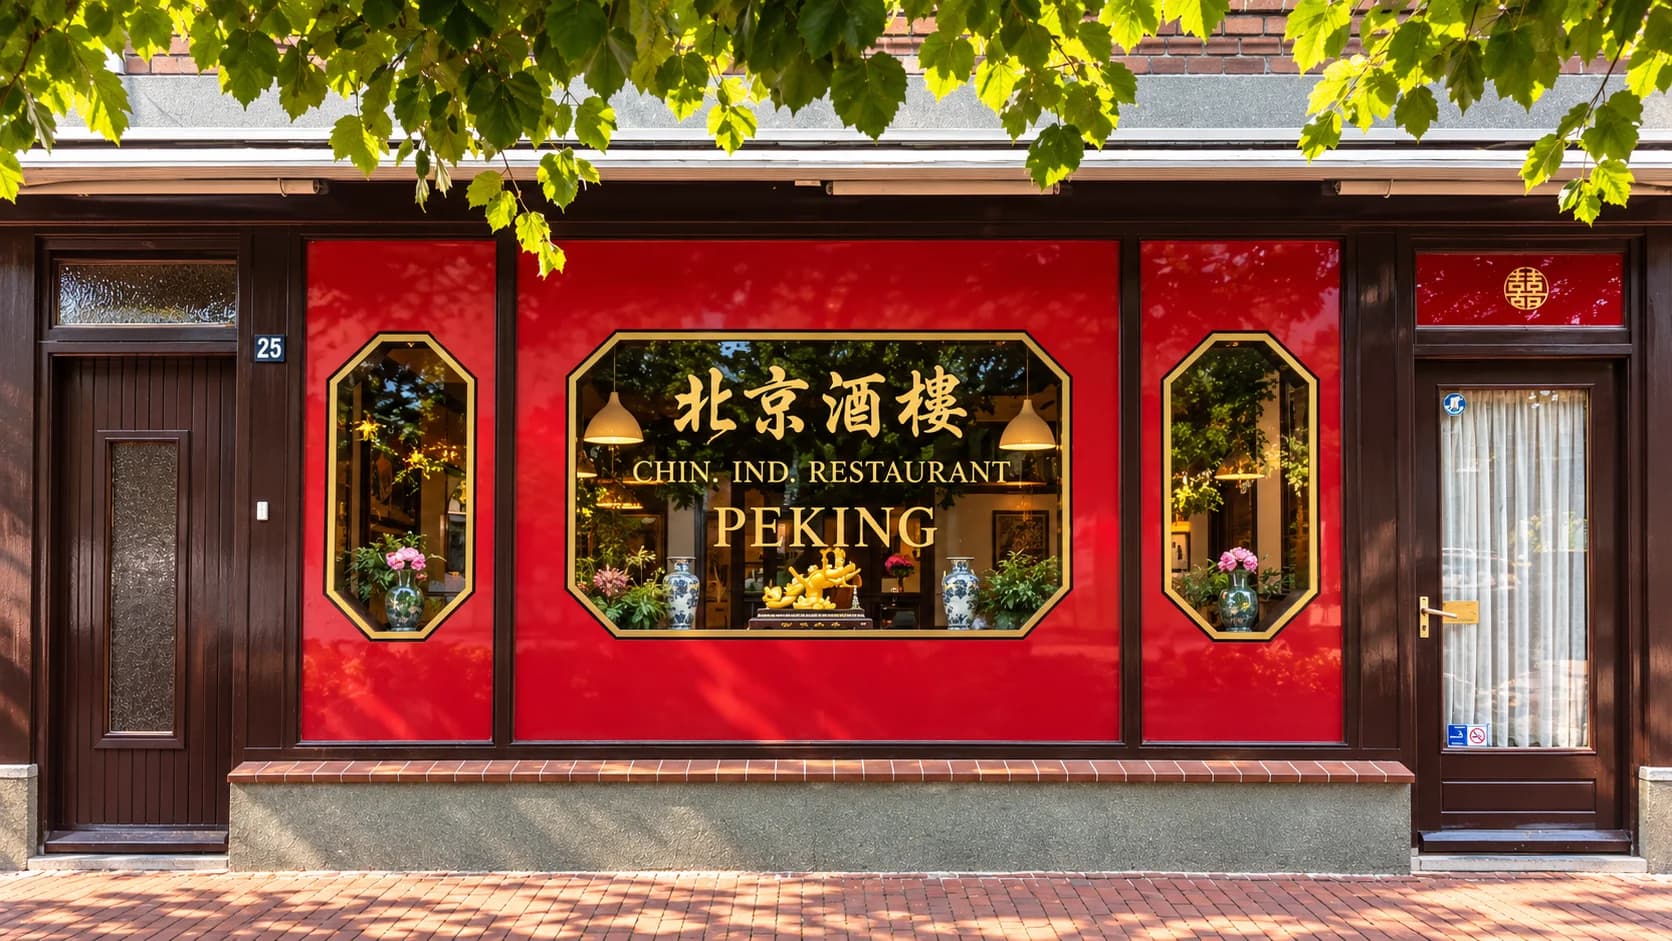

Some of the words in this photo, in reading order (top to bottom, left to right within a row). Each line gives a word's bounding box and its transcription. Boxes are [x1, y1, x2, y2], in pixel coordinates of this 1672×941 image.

[257, 338, 282, 359] 25
[673, 365, 968, 444] 北京酒樓
[632, 460, 719, 484] CHIN.
[733, 460, 797, 484] IND.
[811, 460, 1011, 484] RESTAURANT
[713, 507, 938, 549] PEKING
